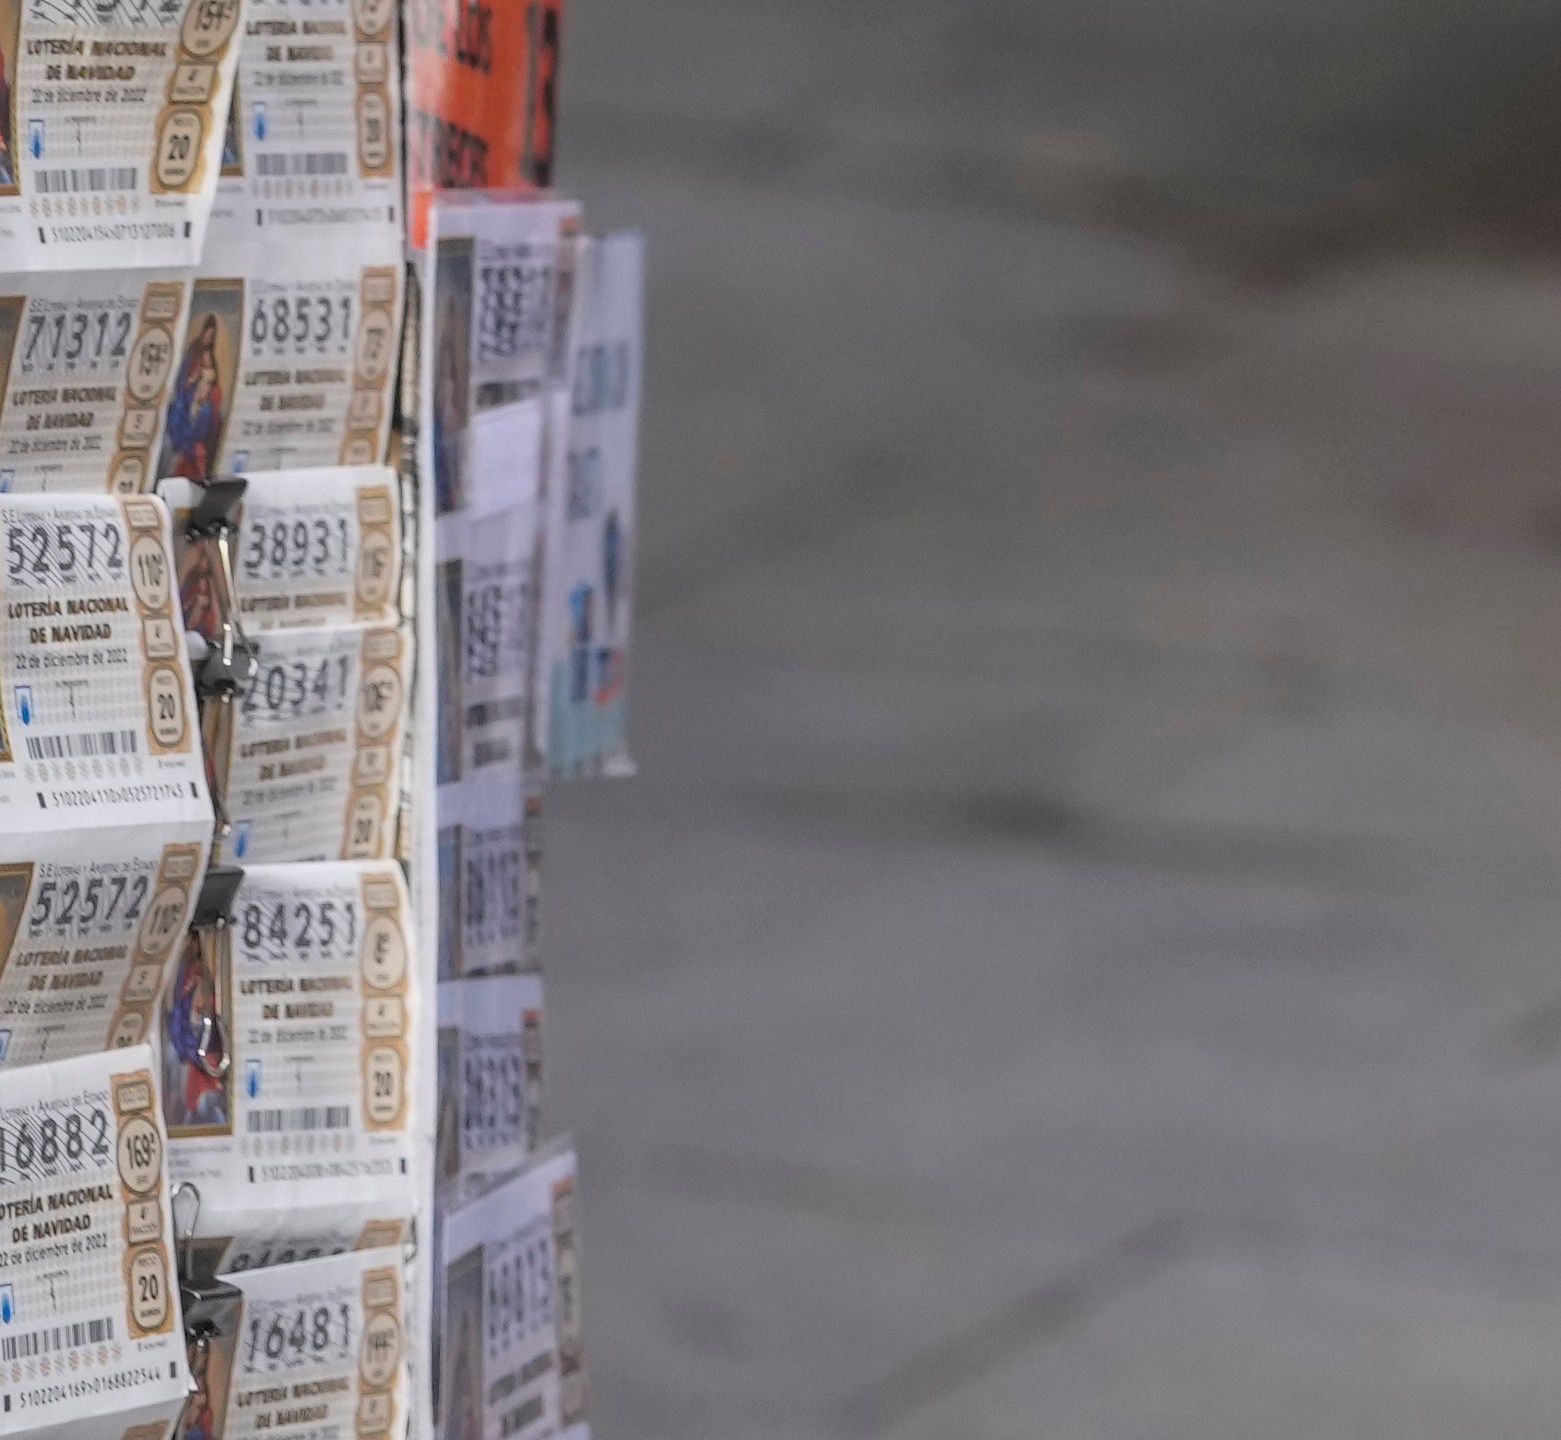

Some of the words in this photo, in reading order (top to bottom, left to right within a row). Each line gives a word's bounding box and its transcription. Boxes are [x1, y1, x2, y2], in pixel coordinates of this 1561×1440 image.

[27, 38, 84, 56] LOTERÍA
[90, 41, 168, 57] NACIONAL
[26, 312, 131, 361] 71312
[251, 296, 351, 343] 68531
[8, 524, 123, 574] 52572
[245, 519, 348, 570] 38931
[8, 595, 63, 619] LOTERÍA
[67, 596, 128, 614] NACIONAL
[30, 627, 49, 644] DE
[51, 622, 111, 643] NAVIDAD
[30, 875, 150, 927] 52572
[243, 901, 357, 949] 84251
[48, 1185, 113, 1212] NACIONAL
[12, 1225, 29, 1244] DE
[33, 1215, 91, 1240] NAVIDAD
[245, 1305, 351, 1361] 16481
